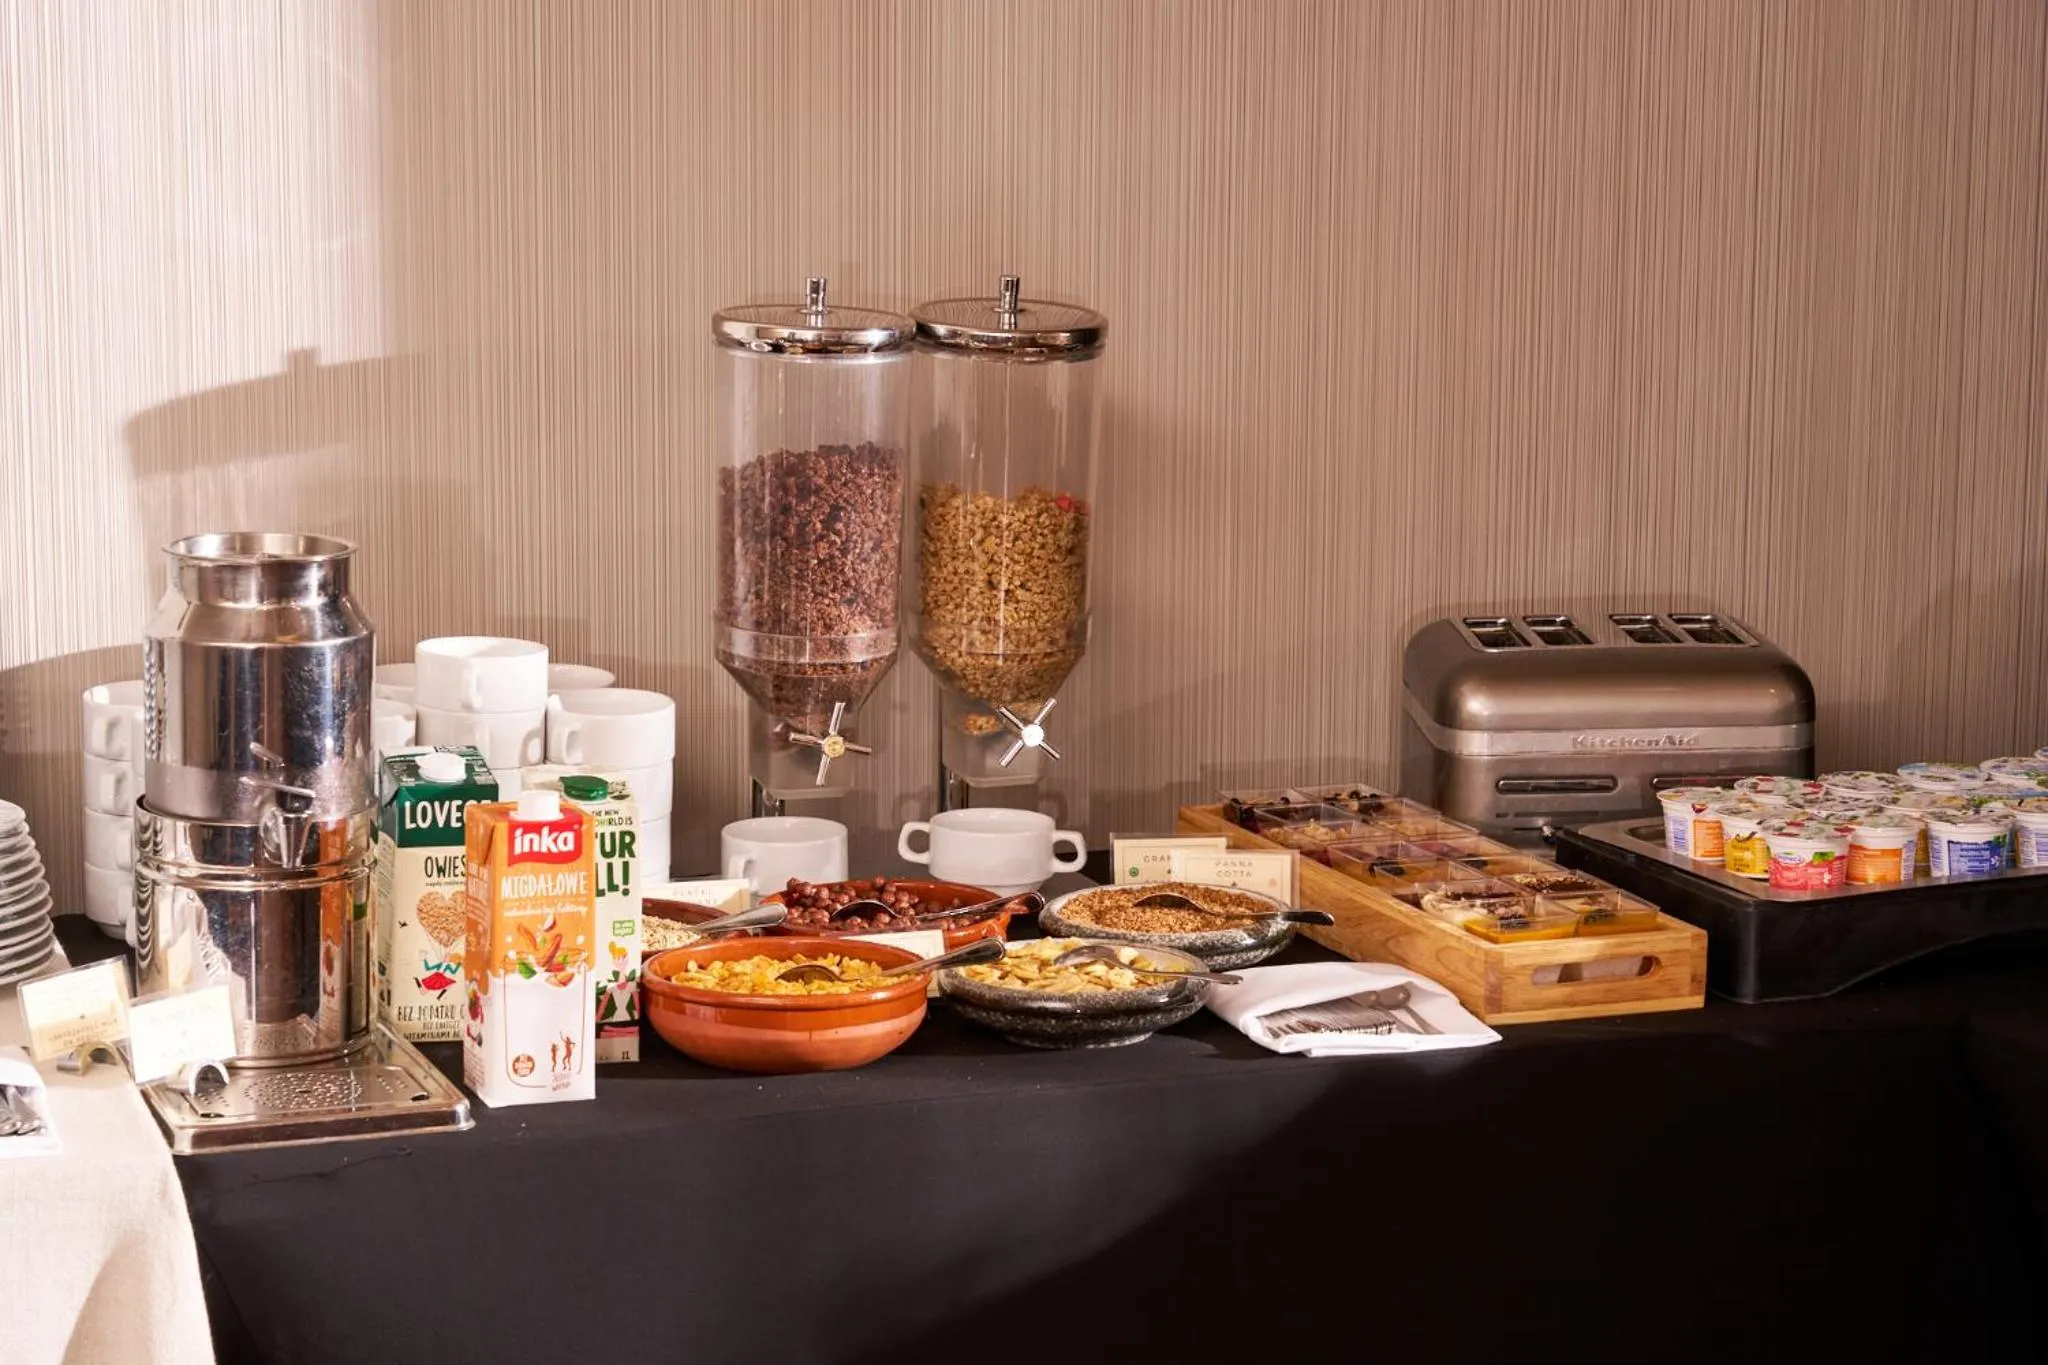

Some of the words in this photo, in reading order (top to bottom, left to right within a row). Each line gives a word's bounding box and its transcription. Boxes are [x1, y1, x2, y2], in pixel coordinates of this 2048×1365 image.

[1570, 733, 1699, 749] KitchenAid
[404, 799, 493, 830] LOVE
[514, 825, 575, 856] inka
[595, 830, 636, 859] UR
[501, 872, 587, 899] MIGDAŁOWE
